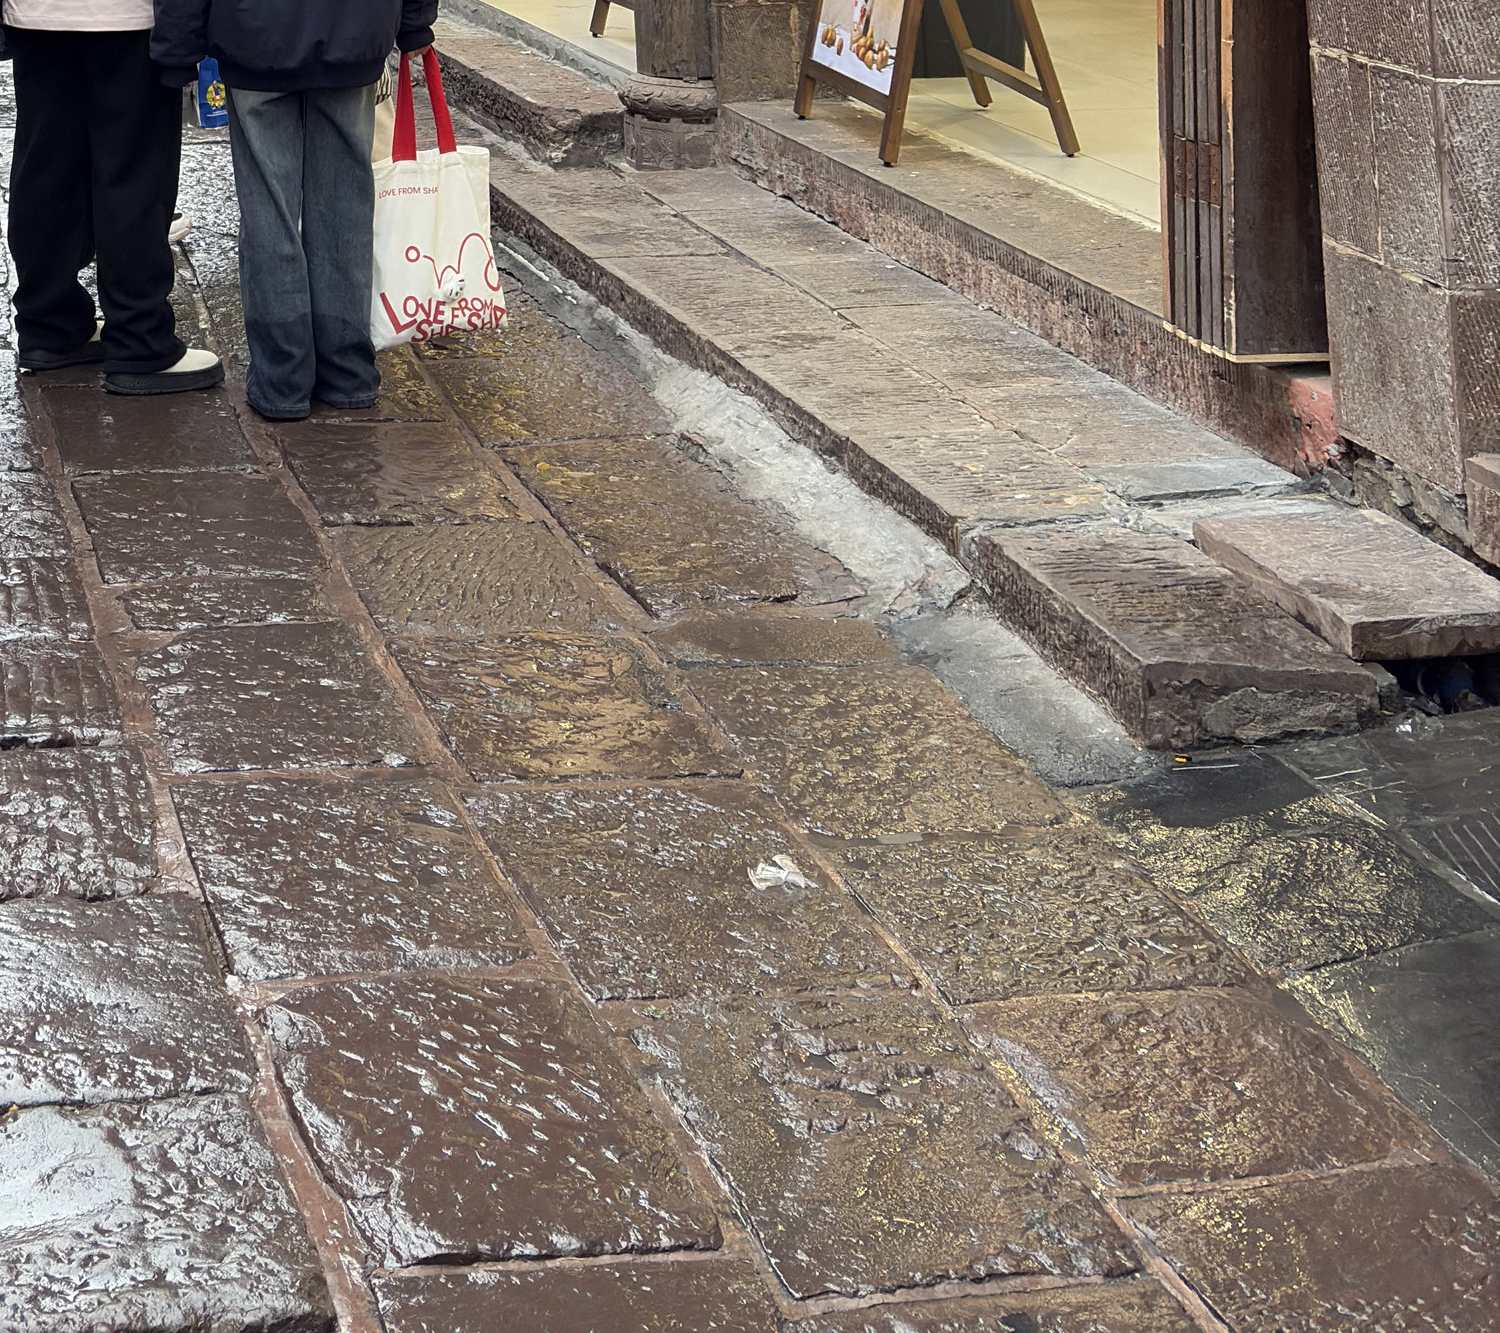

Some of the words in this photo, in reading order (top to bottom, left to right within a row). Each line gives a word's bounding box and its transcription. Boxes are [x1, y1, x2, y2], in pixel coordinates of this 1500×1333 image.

[379, 188, 396, 199] LOVE
[398, 186, 421, 196] FROM
[380, 292, 447, 335] LOVE
[451, 297, 494, 325] FROM
